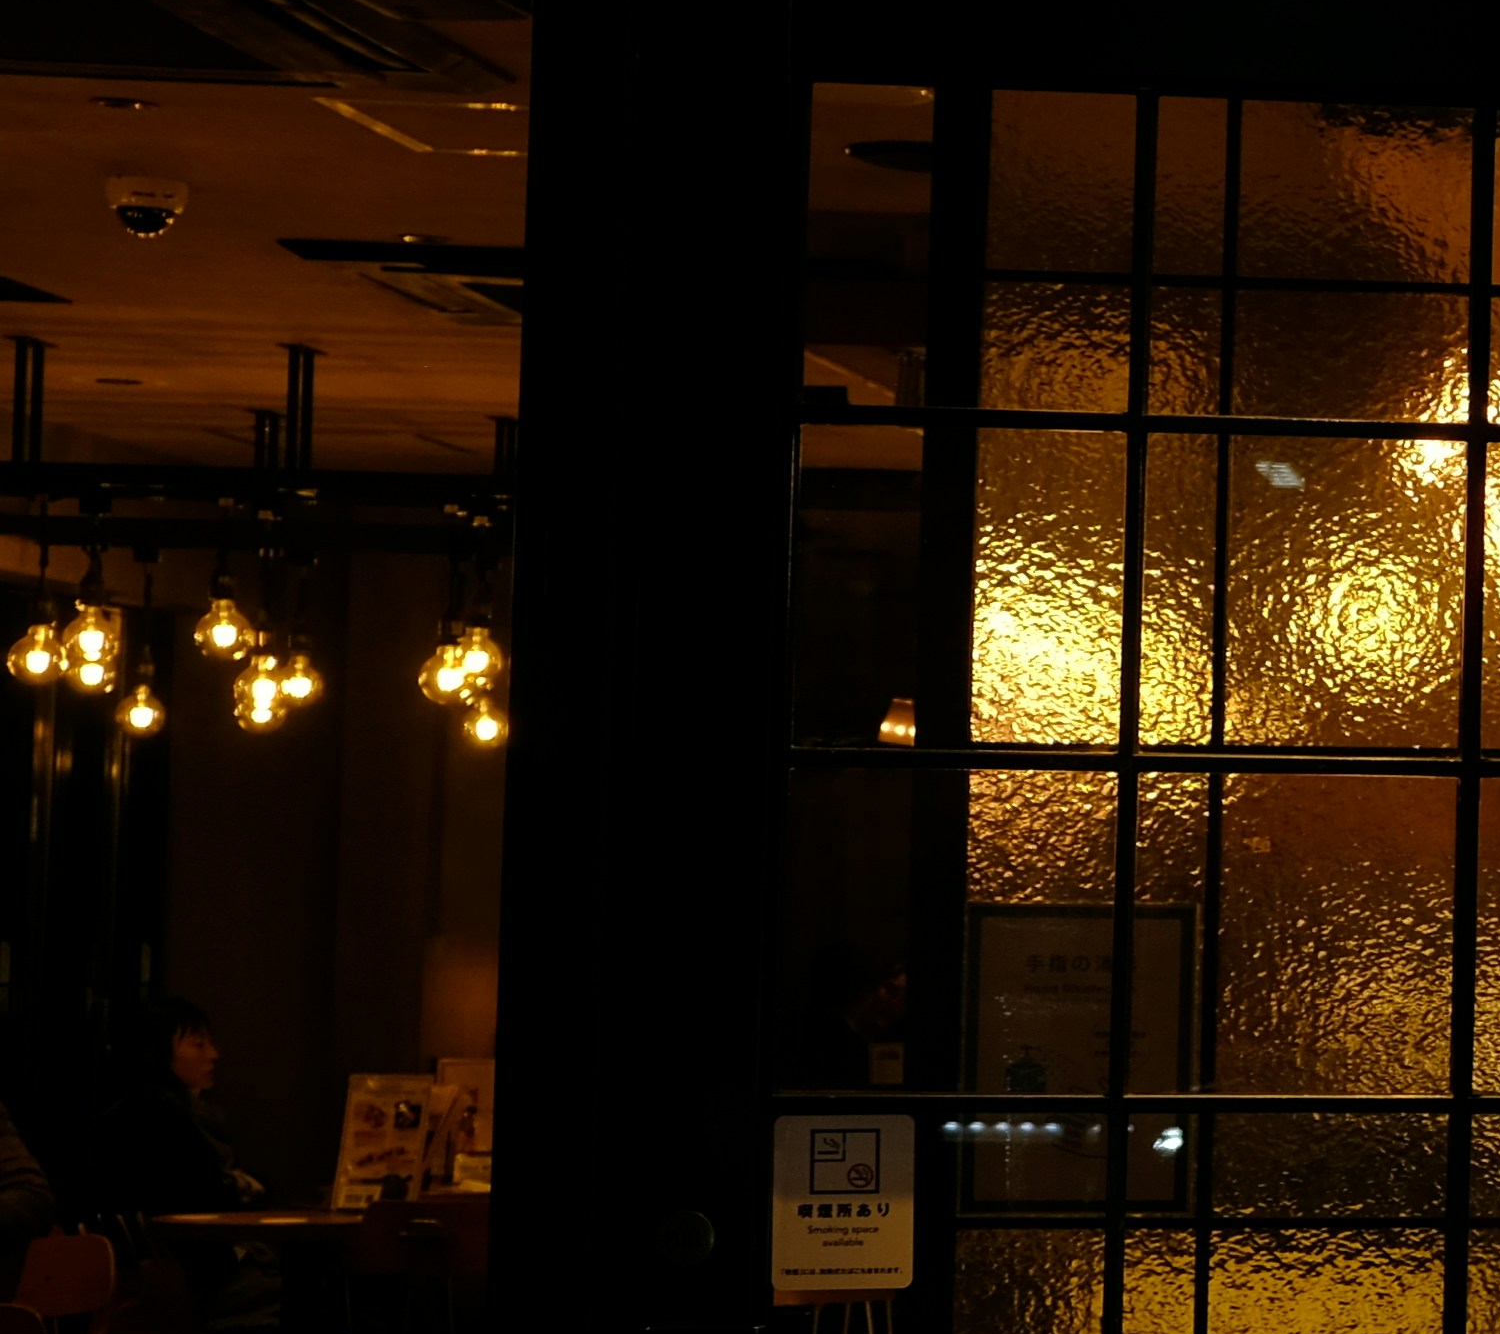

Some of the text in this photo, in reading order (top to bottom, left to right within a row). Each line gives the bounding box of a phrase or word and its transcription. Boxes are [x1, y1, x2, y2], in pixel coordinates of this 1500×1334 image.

[807, 1225, 880, 1235] Smoking space
[822, 1238, 864, 1246] available
